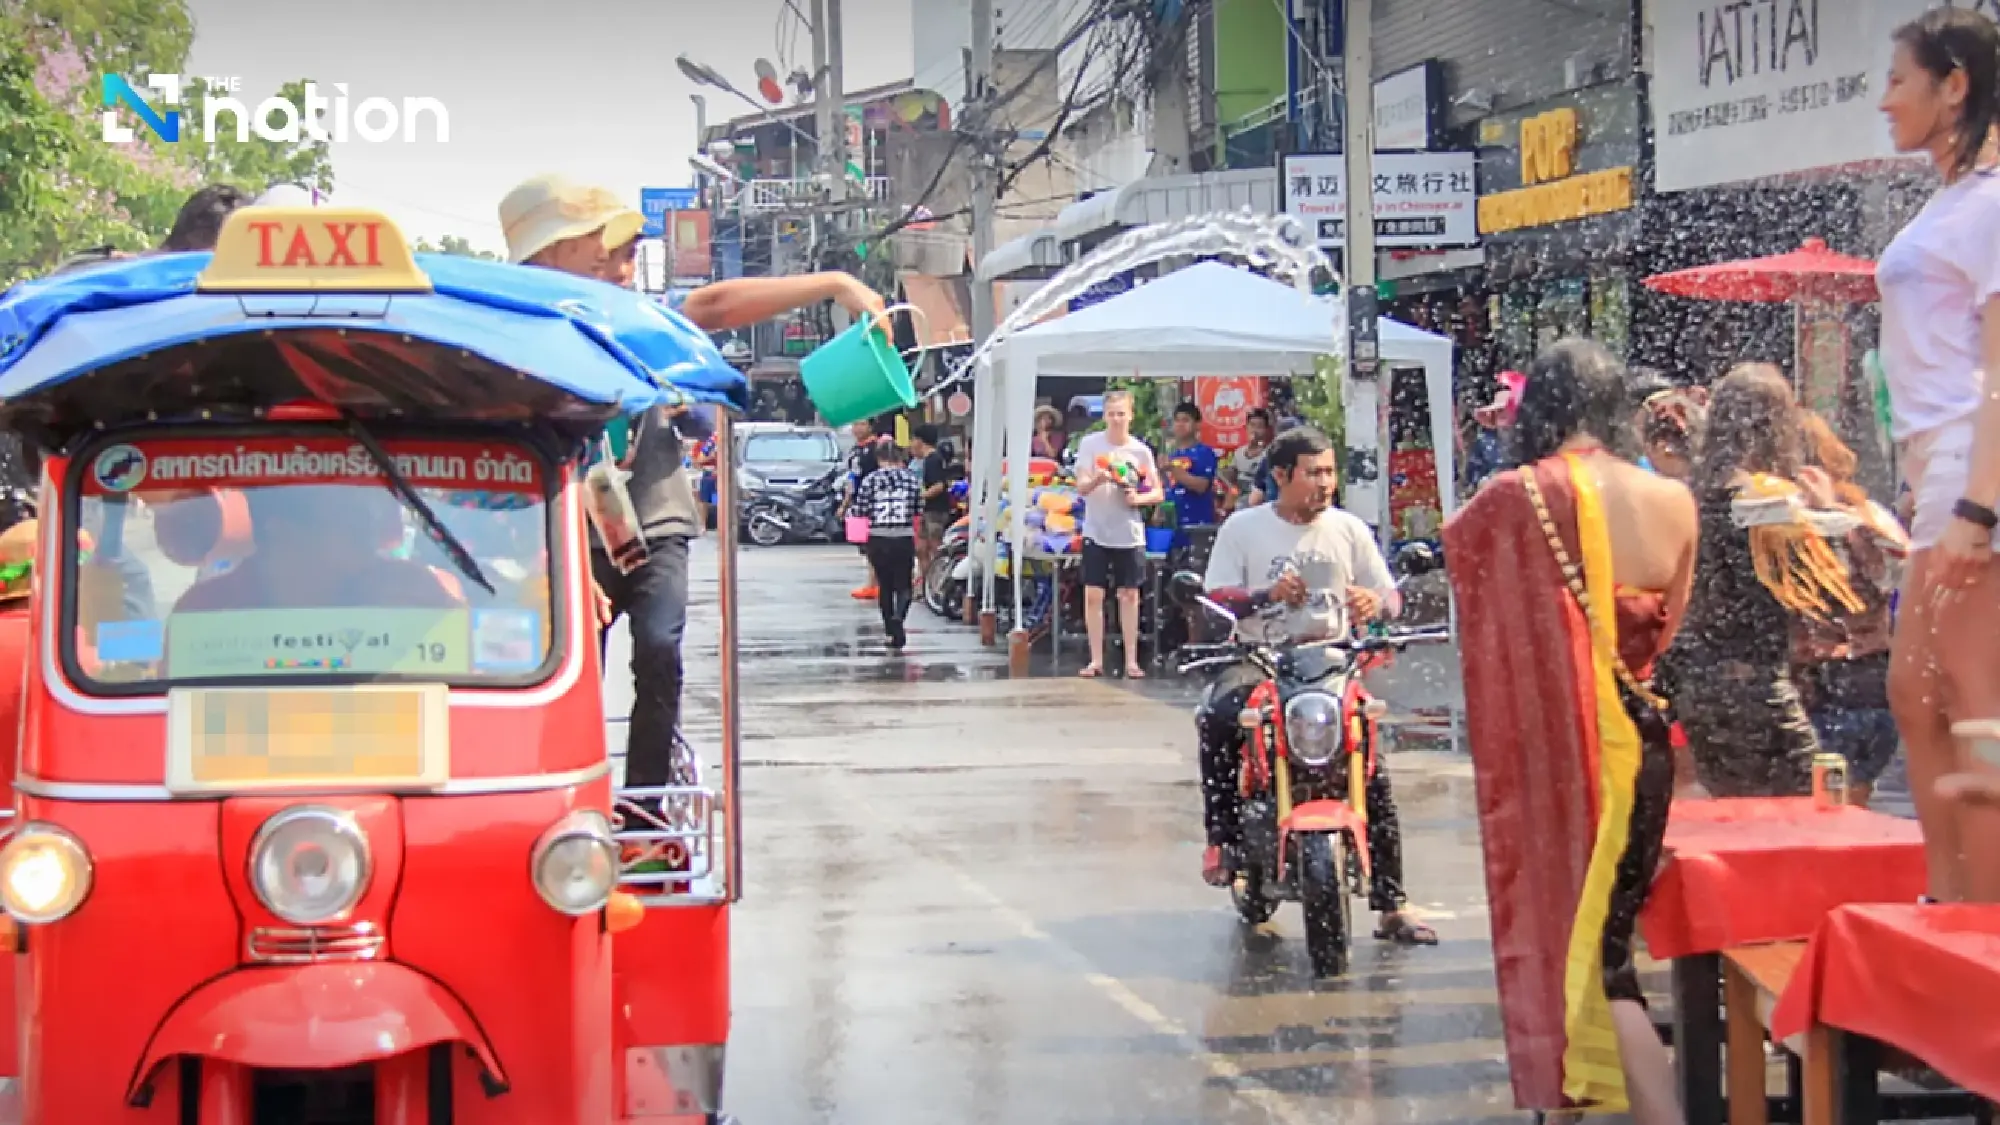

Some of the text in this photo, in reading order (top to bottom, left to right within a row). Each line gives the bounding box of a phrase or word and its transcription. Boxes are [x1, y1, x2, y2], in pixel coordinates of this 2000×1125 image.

[248, 222, 383, 268] TAXI
[474, 449, 533, 484] จำกัด
[874, 501, 907, 523] 23
[417, 642, 446, 663] 19
